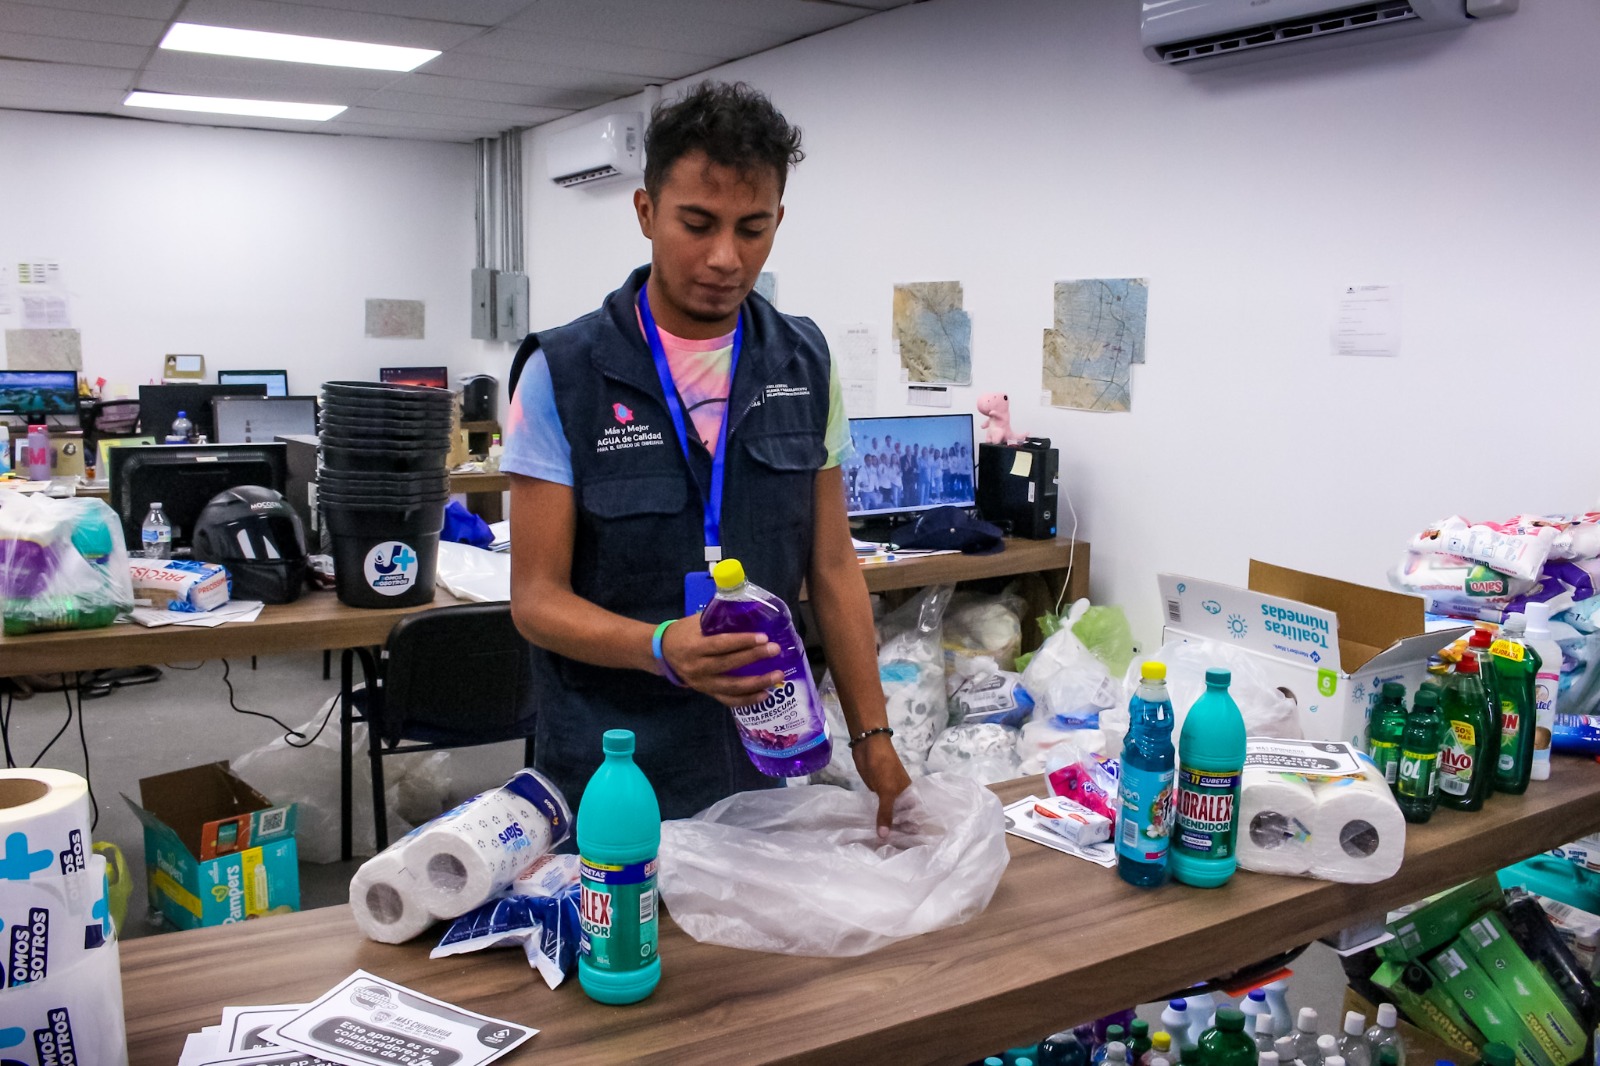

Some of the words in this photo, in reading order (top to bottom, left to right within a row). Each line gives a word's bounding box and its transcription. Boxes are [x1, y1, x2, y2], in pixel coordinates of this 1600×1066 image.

[597, 437, 621, 446] AGUA
[633, 432, 662, 441] Calidad
[604, 427, 620, 435] Más
[1470, 581, 1504, 592] Salvo
[1261, 603, 1329, 634] húmedas
[1265, 619, 1329, 649] Toallitas
[1322, 676, 1331, 688] 6
[761, 697, 796, 719] FRESCURA
[1455, 727, 1472, 735] 50%
[1191, 775, 1200, 785] 11
[1181, 817, 1230, 831] RENDIDOR
[223, 864, 245, 926] Pampers
[334, 1029, 420, 1057] colaboradores
[339, 1021, 366, 1034] Este
[367, 1031, 405, 1046] apoyo
[406, 1042, 421, 1050] es
[423, 1047, 439, 1056] de
[334, 1037, 380, 1054] amigos
[380, 1050, 397, 1058] de
